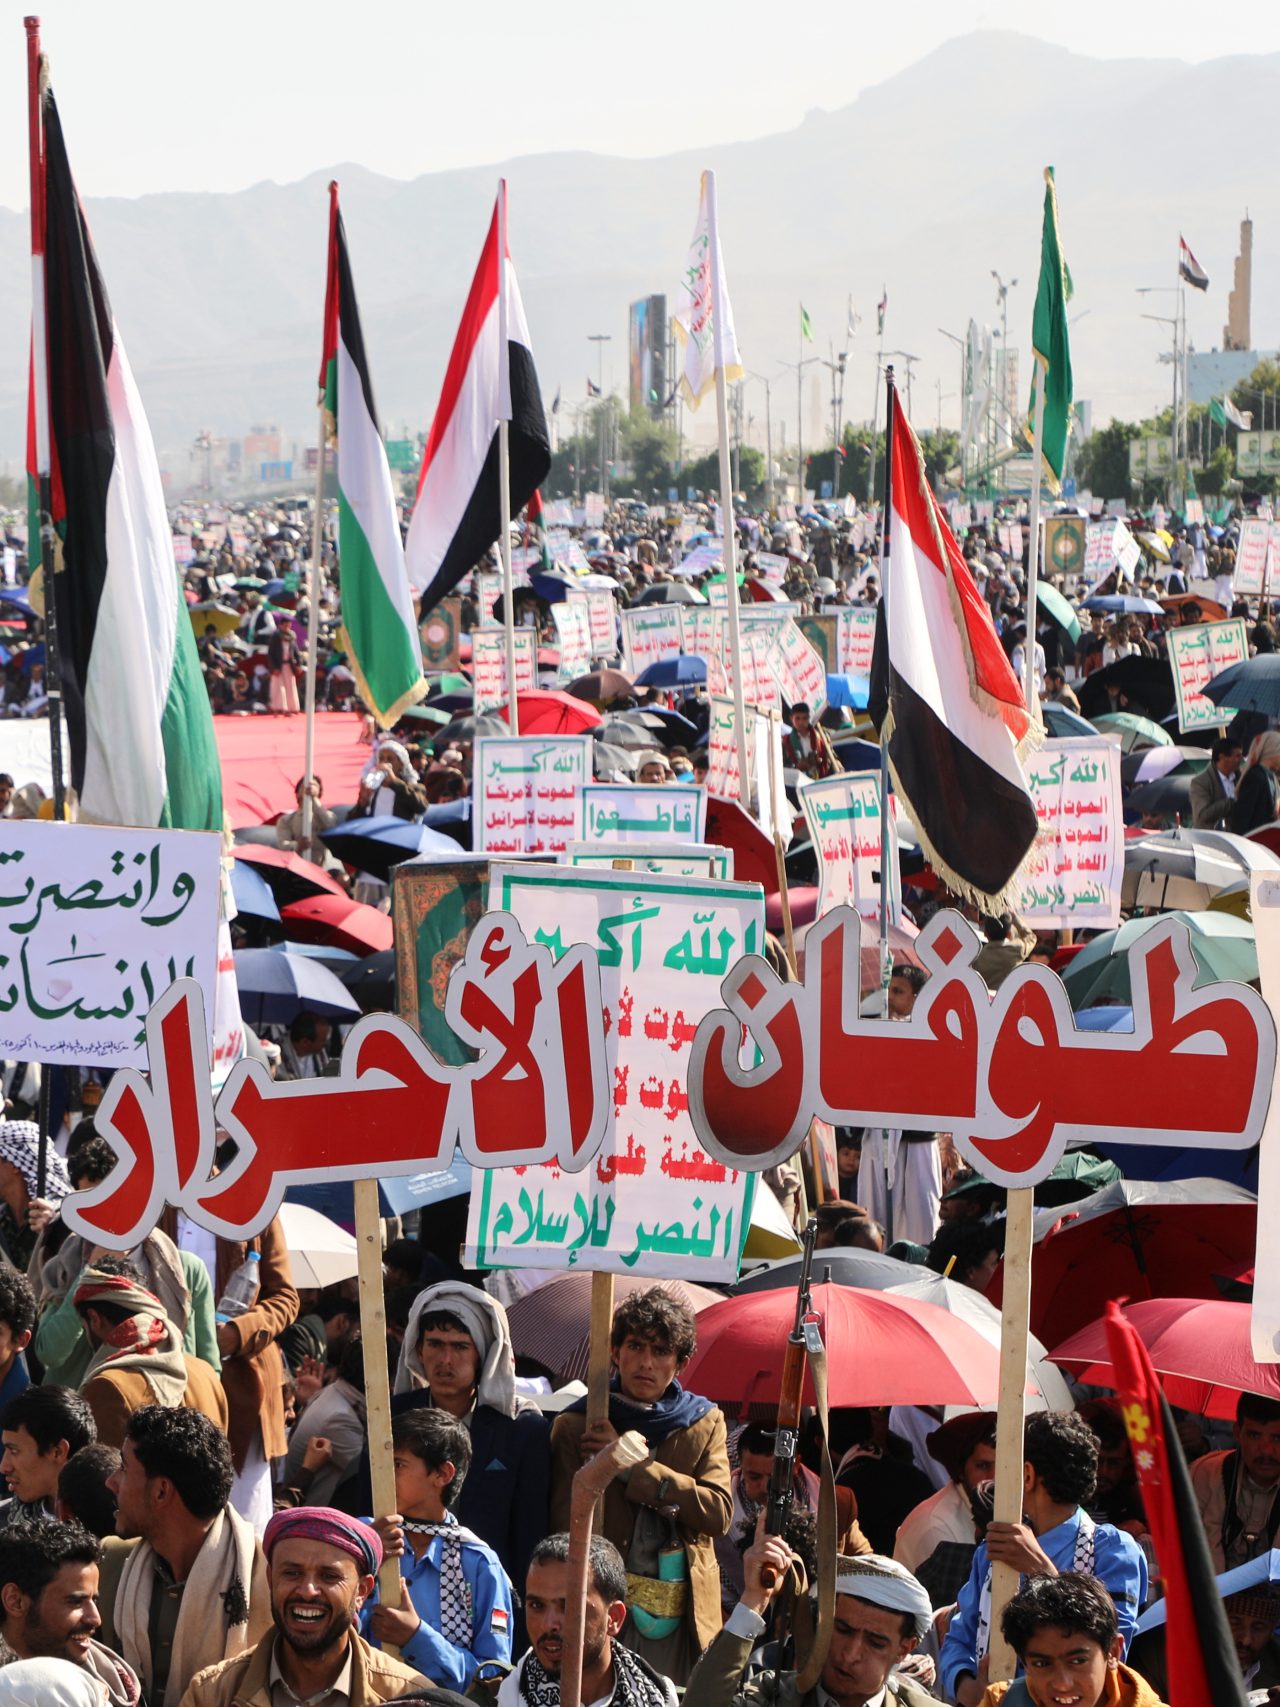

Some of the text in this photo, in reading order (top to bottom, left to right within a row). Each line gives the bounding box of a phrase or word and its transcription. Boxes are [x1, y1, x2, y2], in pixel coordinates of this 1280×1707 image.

[486, 742, 581, 782] الله أكبر
[1070, 755, 1108, 783] الله
[485, 781, 576, 805] لموت لأمريكا
[808, 789, 880, 830] قاطعوا
[1063, 796, 1108, 818] الموت
[537, 810, 575, 830] لموت
[588, 802, 692, 838] قاطعوا
[1065, 824, 1108, 846] الموت
[851, 834, 882, 865] لبضائع
[1076, 853, 1107, 872] اللعنة
[1068, 880, 1106, 911] النصر
[663, 911, 757, 977] الله
[701, 921, 1258, 1174] طوفان
[75, 925, 594, 1237] الأحرار
[596, 1133, 647, 1184] على
[491, 1186, 734, 1269] النصر للإسلام
